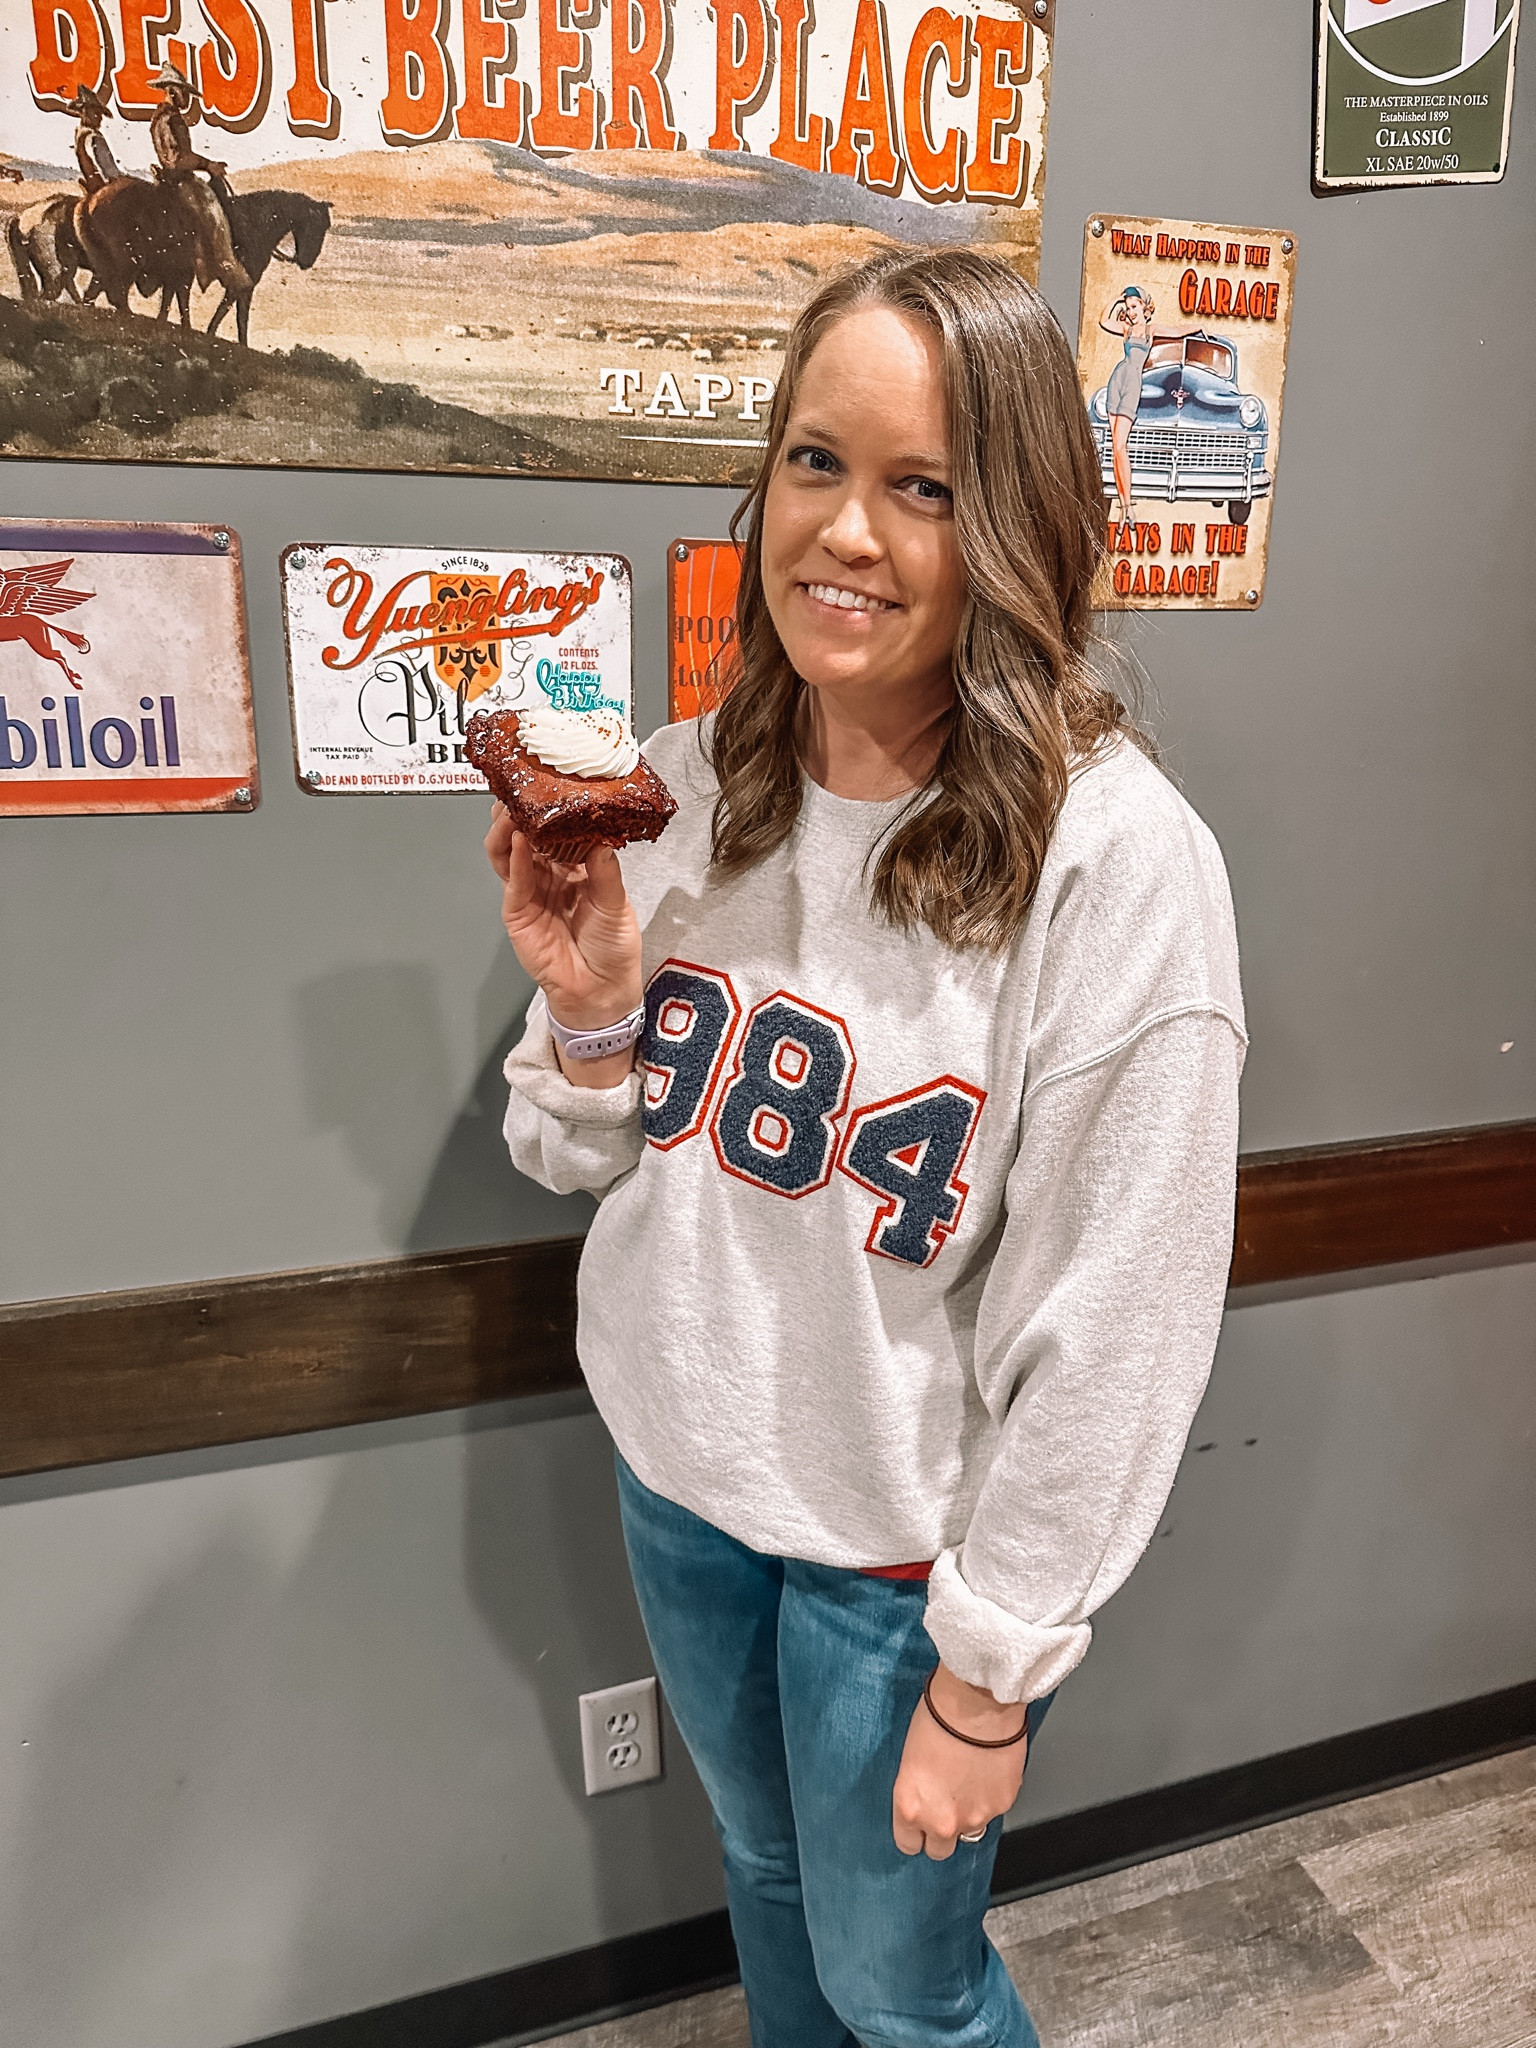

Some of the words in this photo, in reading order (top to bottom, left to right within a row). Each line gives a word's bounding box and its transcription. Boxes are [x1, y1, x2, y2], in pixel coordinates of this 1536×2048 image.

[379, 0, 684, 156] BEER
[707, 0, 1032, 204] PLACE
[1344, 96, 1367, 108] THE
[1370, 95, 1446, 108] MASTERPIECE
[1448, 95, 1461, 106] IN
[1463, 94, 1488, 106] OILS
[1380, 111, 1426, 123] Established
[1429, 111, 1449, 121] 1899
[1375, 127, 1451, 148] CLASSIC
[1366, 157, 1385, 172] XL
[1387, 156, 1413, 171] SAE
[1416, 154, 1459, 170] 20w/50
[1111, 229, 1151, 256] WHAT
[1156, 233, 1220, 262] HAPPENS
[1225, 243, 1240, 264] IN
[1245, 245, 1270, 266] THE
[1179, 268, 1279, 320] GARAGE
[600, 367, 777, 421] TAPP
[1107, 522, 1161, 553] TAYS
[1171, 523, 1195, 553] IN
[1206, 524, 1248, 554] THE
[441, 556, 467, 570] SINCE
[470, 558, 489, 572] 1829
[1114, 559, 1220, 596] GARAGE!
[321, 557, 605, 670] Yuengling's
[559, 648, 599, 657] CONTENTS
[561, 661, 568, 670] 12
[536, 658, 601, 697] Happy
[358, 660, 489, 747] Pil
[0, 696, 180, 769] biloil
[318, 774, 337, 786] ADE
[339, 774, 358, 785] AND
[361, 774, 400, 785] BOTTLED
[402, 774, 414, 784] BY
